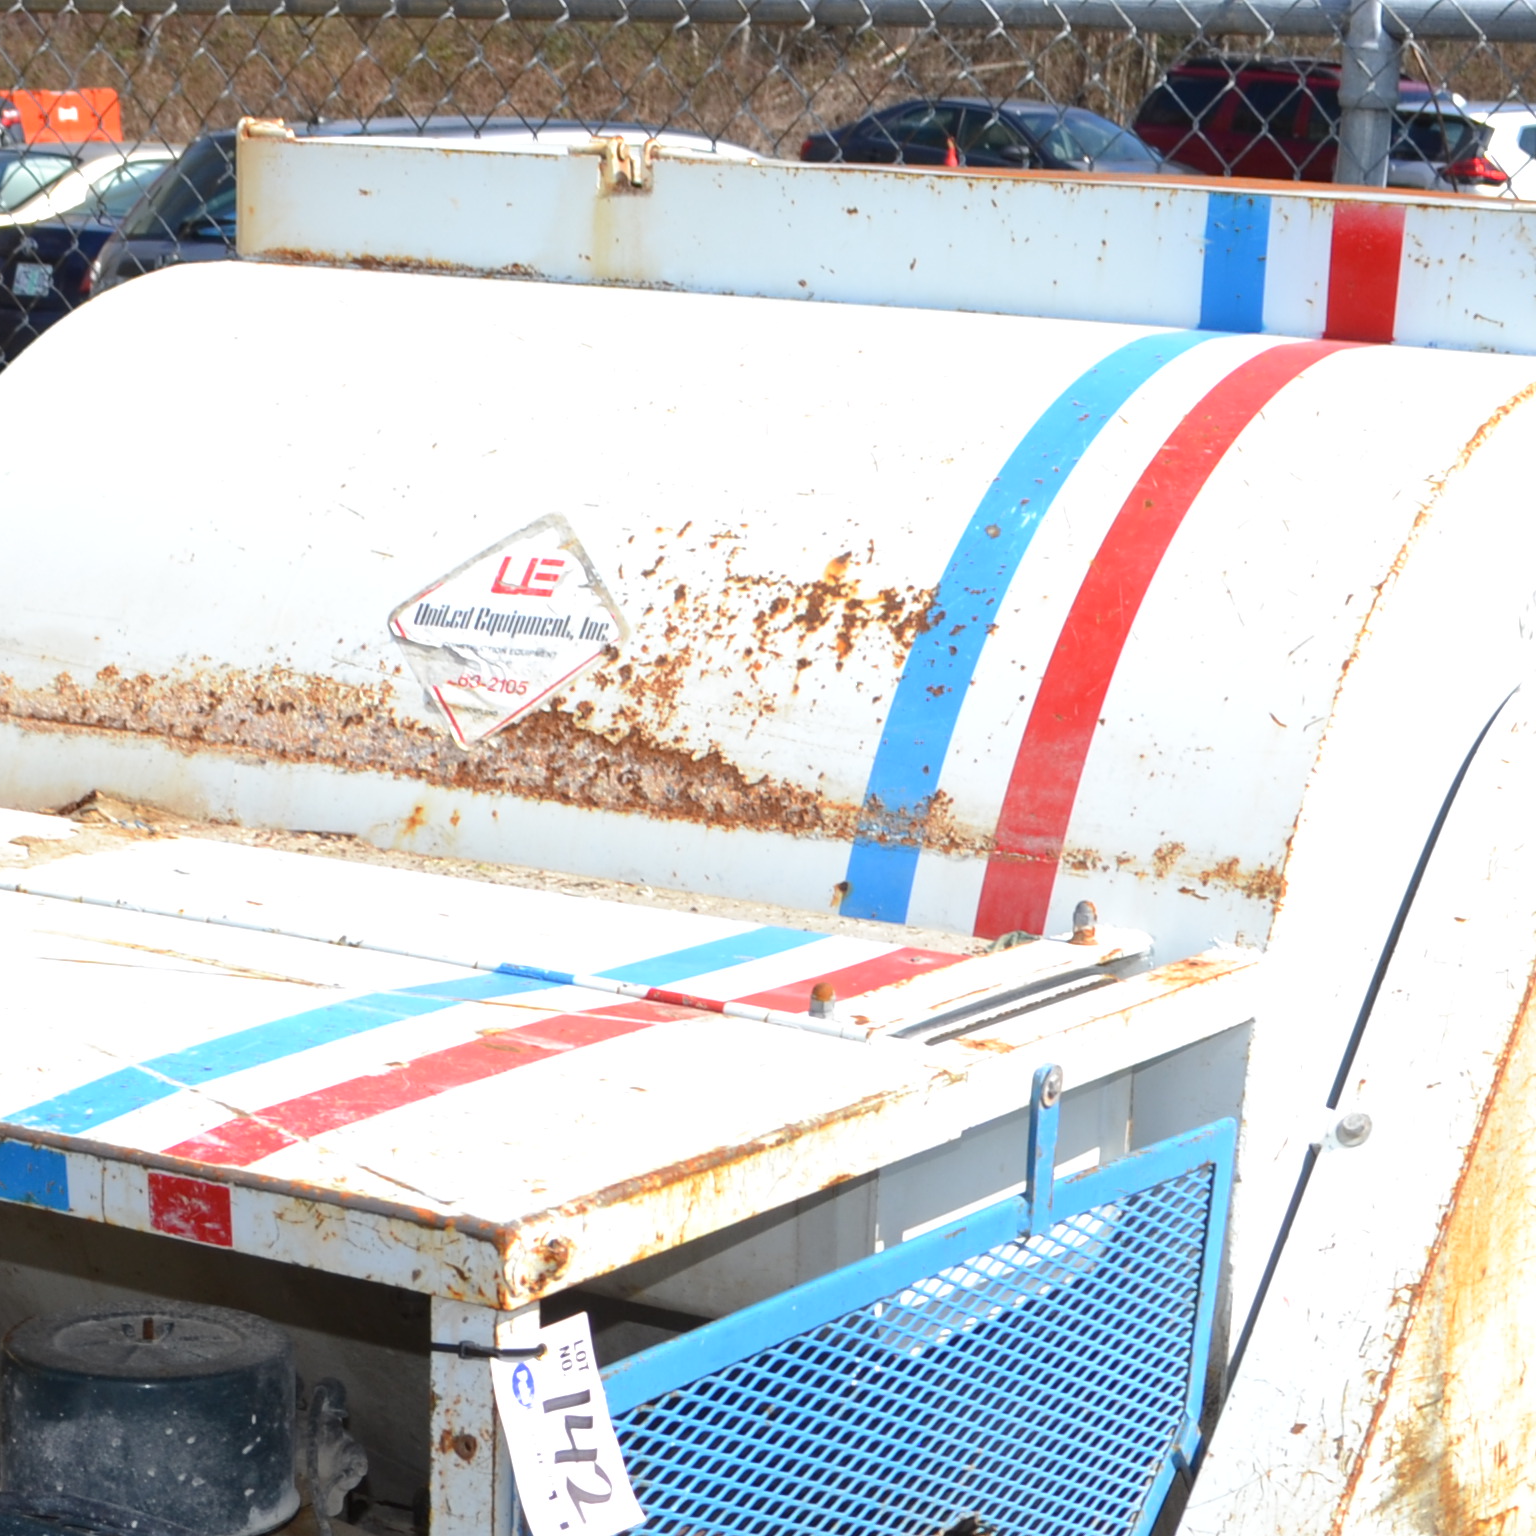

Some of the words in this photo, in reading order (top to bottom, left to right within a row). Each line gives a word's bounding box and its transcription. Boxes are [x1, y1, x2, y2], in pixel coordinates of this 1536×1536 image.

[413, 603, 475, 630] United
[579, 616, 610, 643] Inc.
[558, 1345, 574, 1377] NO.
[572, 1339, 589, 1372] LOT
[542, 1389, 613, 1524] 142
